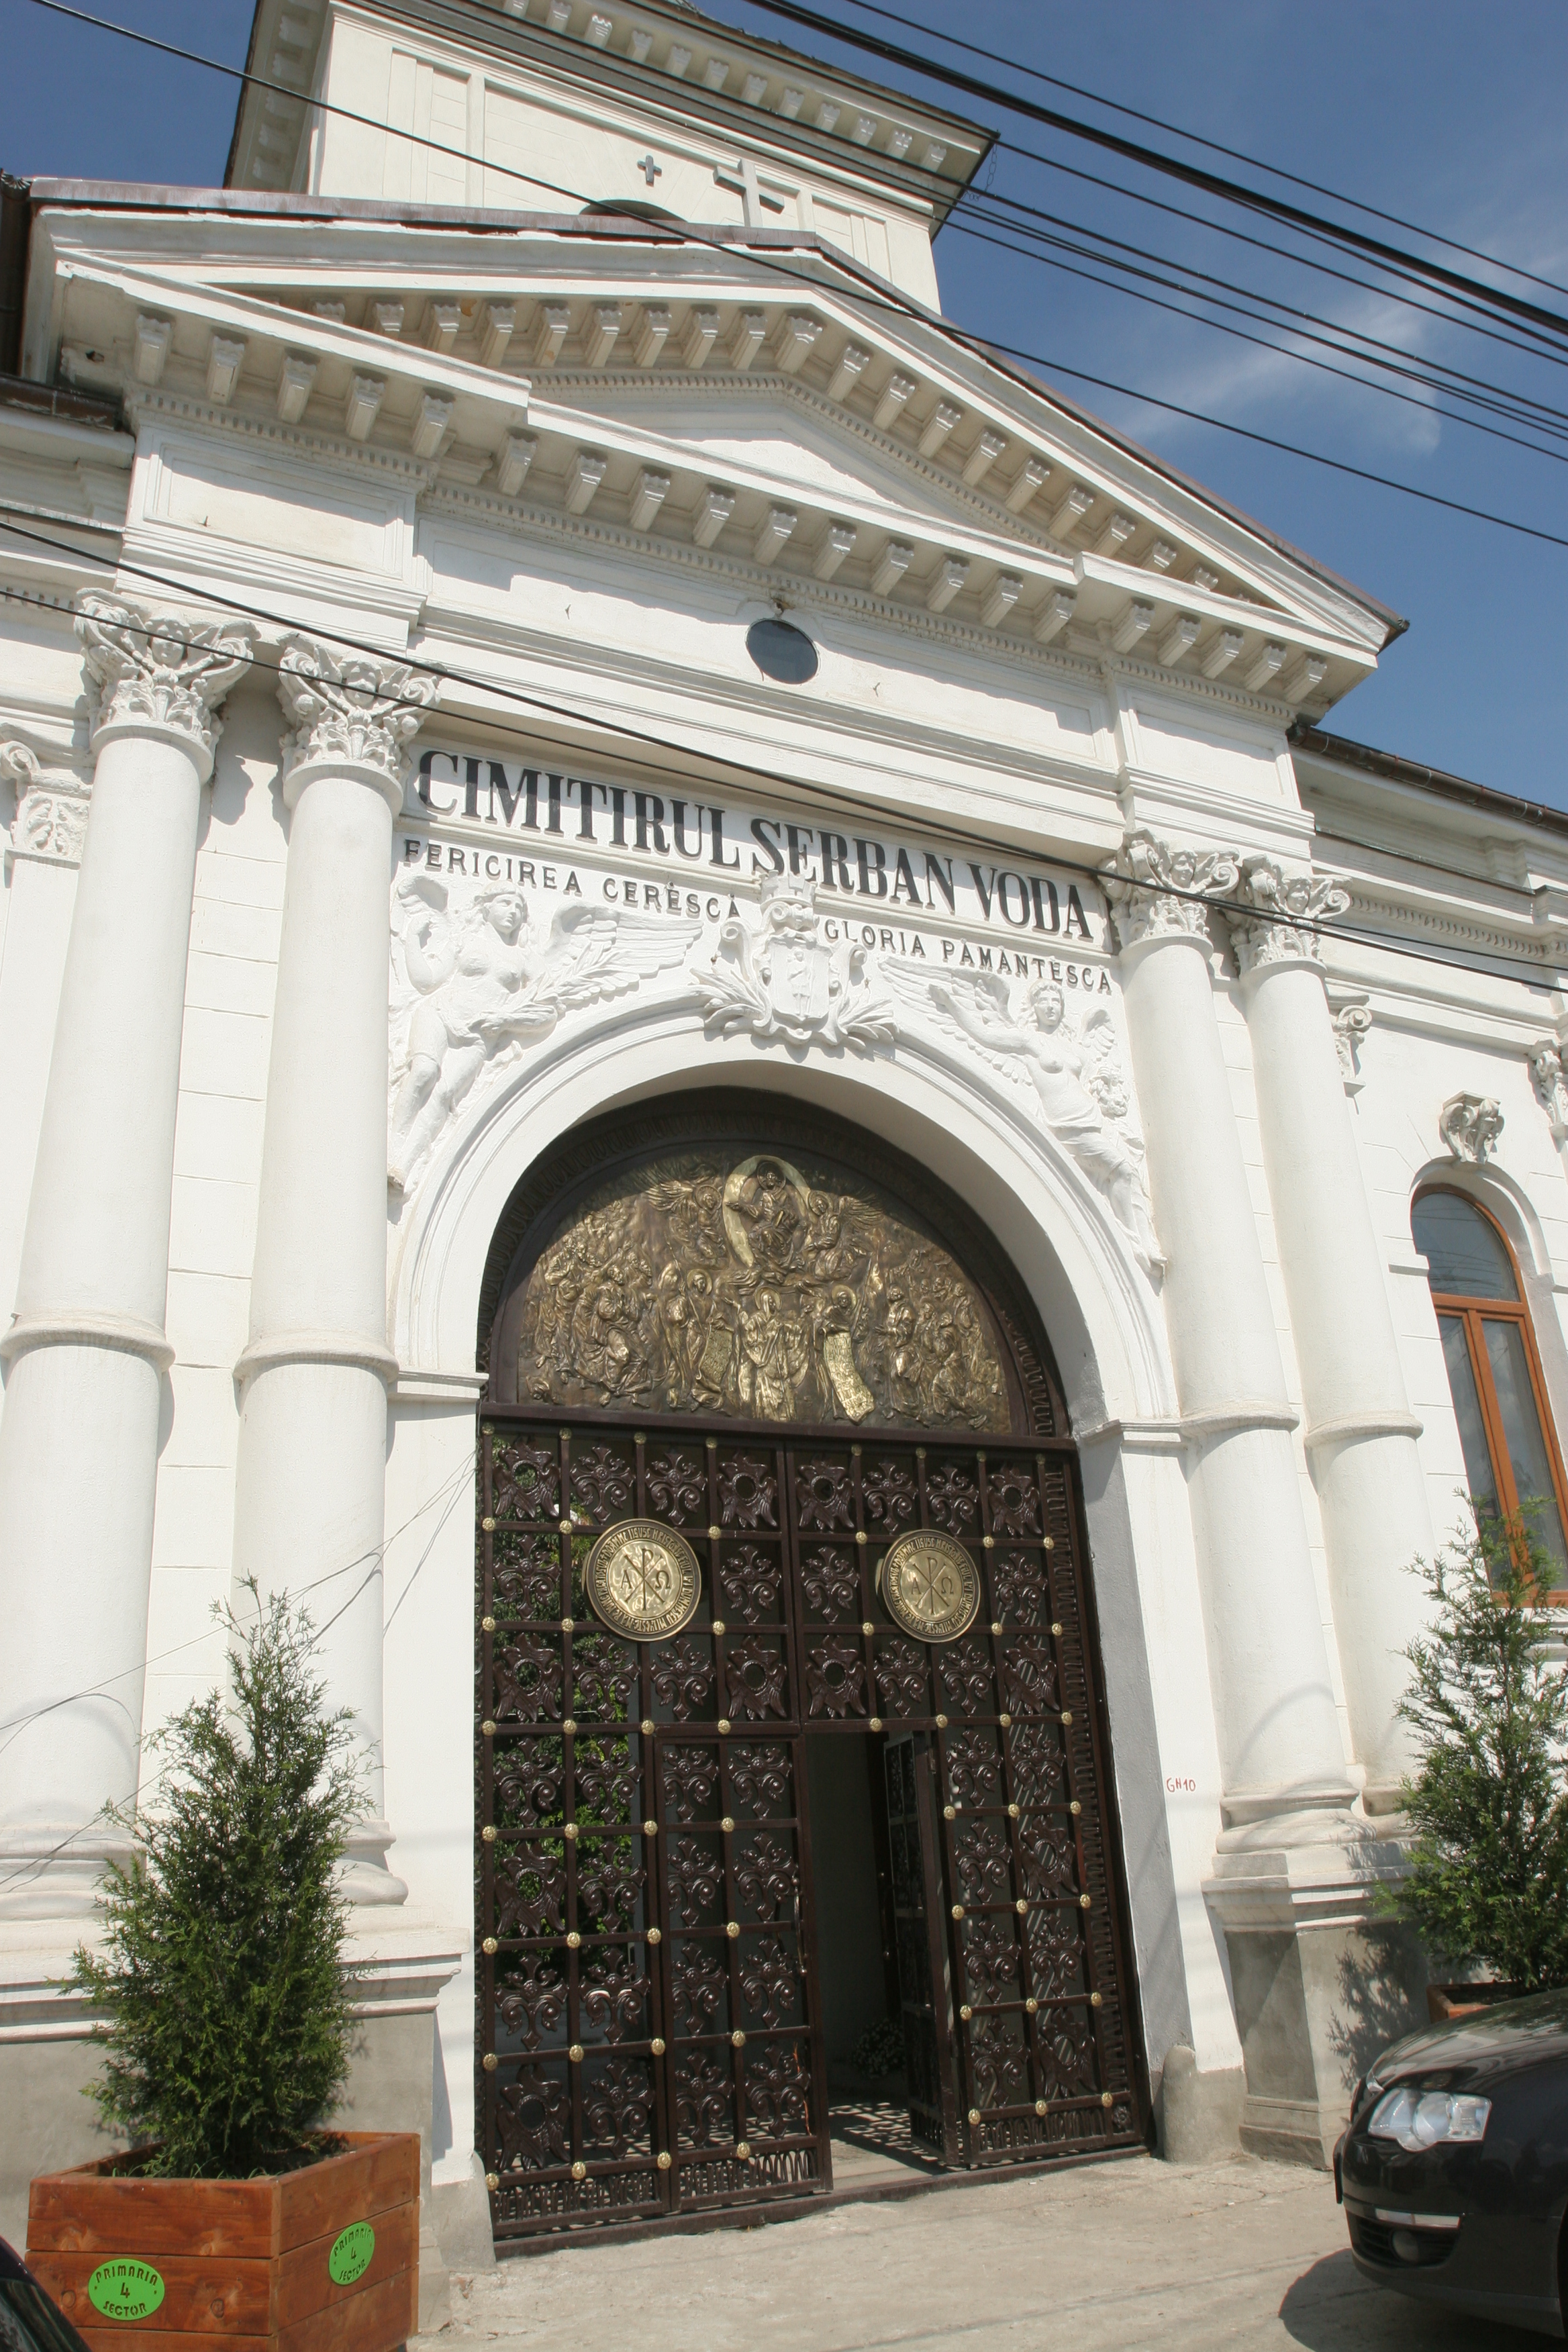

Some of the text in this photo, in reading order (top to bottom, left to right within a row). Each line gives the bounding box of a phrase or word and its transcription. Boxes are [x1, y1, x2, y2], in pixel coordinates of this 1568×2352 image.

[419, 750, 741, 870] CIMITIRUL
[966, 863, 1094, 942] VODA
[404, 839, 582, 897] FERICIREA
[824, 918, 926, 959] GLORIA
[333, 2226, 371, 2257] PRIMARIA
[350, 2247, 356, 2261] 4
[95, 2265, 158, 2287] PRIMARIA
[339, 2259, 366, 2281] SECTOR
[119, 2283, 130, 2298] 4
[103, 2300, 147, 2317] SECTOR
